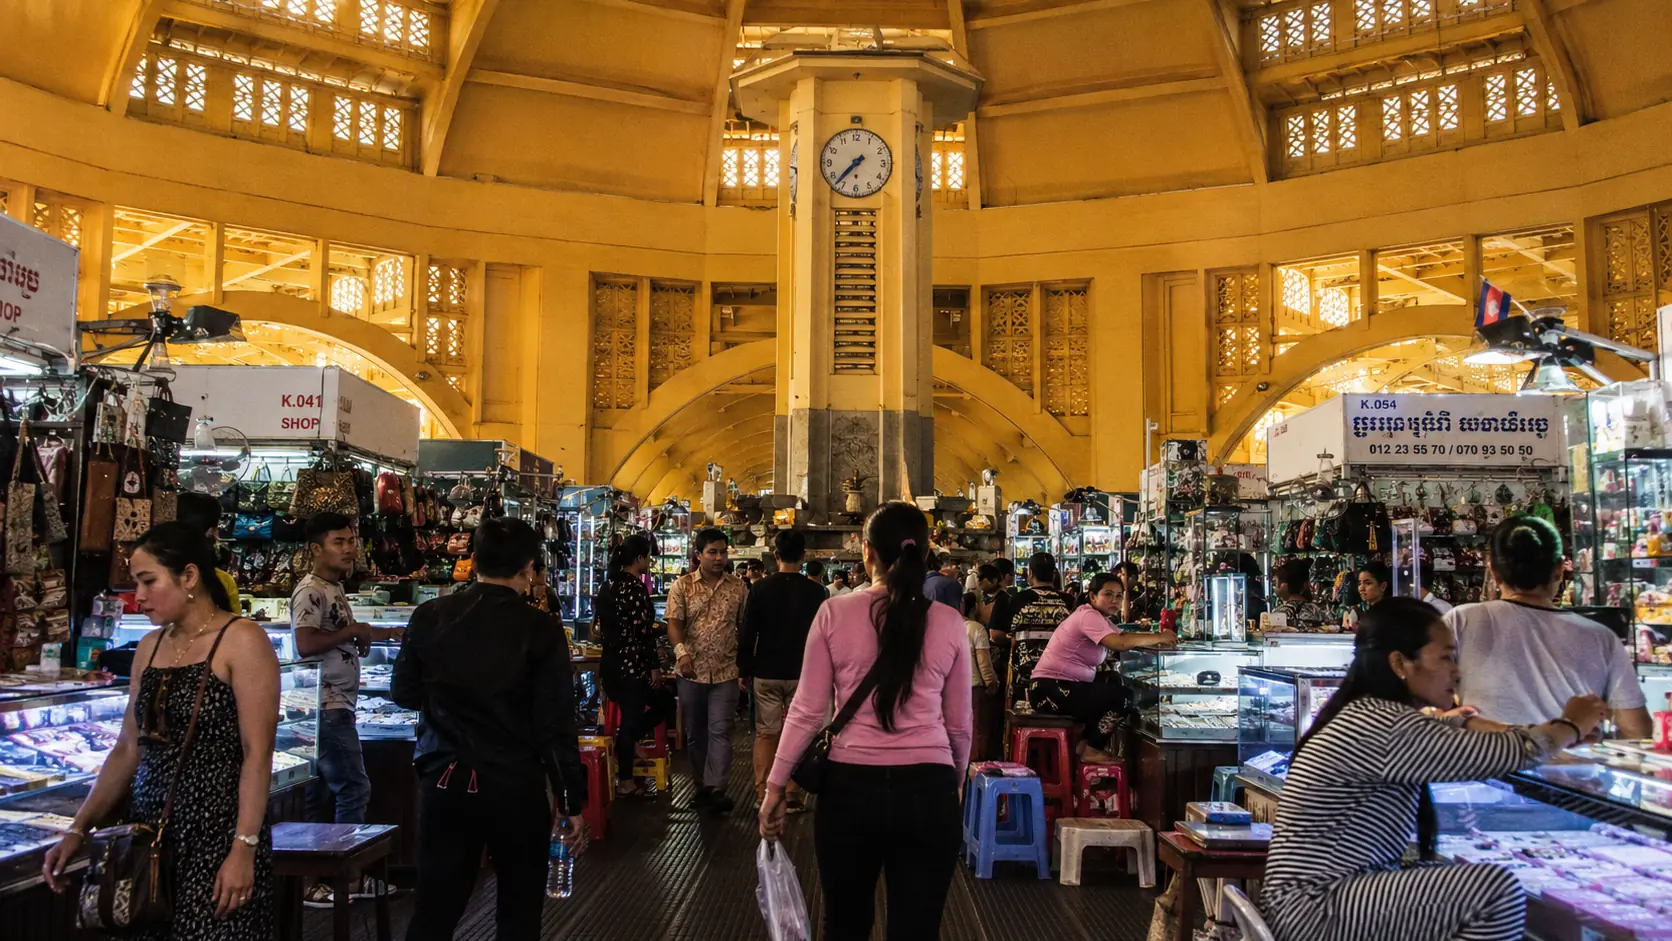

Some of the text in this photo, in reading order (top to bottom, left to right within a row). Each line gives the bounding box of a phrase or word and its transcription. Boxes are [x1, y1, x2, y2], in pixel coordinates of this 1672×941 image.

[840, 137, 847, 145] 11
[852, 134, 861, 142] 12
[829, 146, 837, 154] 10
[877, 147, 883, 155] 2
[826, 159, 833, 167] 9
[880, 159, 886, 168] 3
[830, 171, 837, 180] 8
[876, 172, 882, 180] 4
[841, 181, 846, 189] 7
[853, 184, 859, 192] 6
[866, 181, 872, 189] 5
[281, 394, 323, 408] K.041
[1360, 399, 1397, 410] K.054
[281, 417, 320, 430] SHOP
[1369, 444, 1391, 455] 012
[1394, 444, 1409, 455] 23
[1413, 444, 1428, 455] 55
[1431, 444, 1446, 455] 70
[1456, 444, 1478, 455] 070
[1481, 444, 1496, 455] 93
[1500, 444, 1515, 455] 50
[1518, 444, 1533, 455] 50
